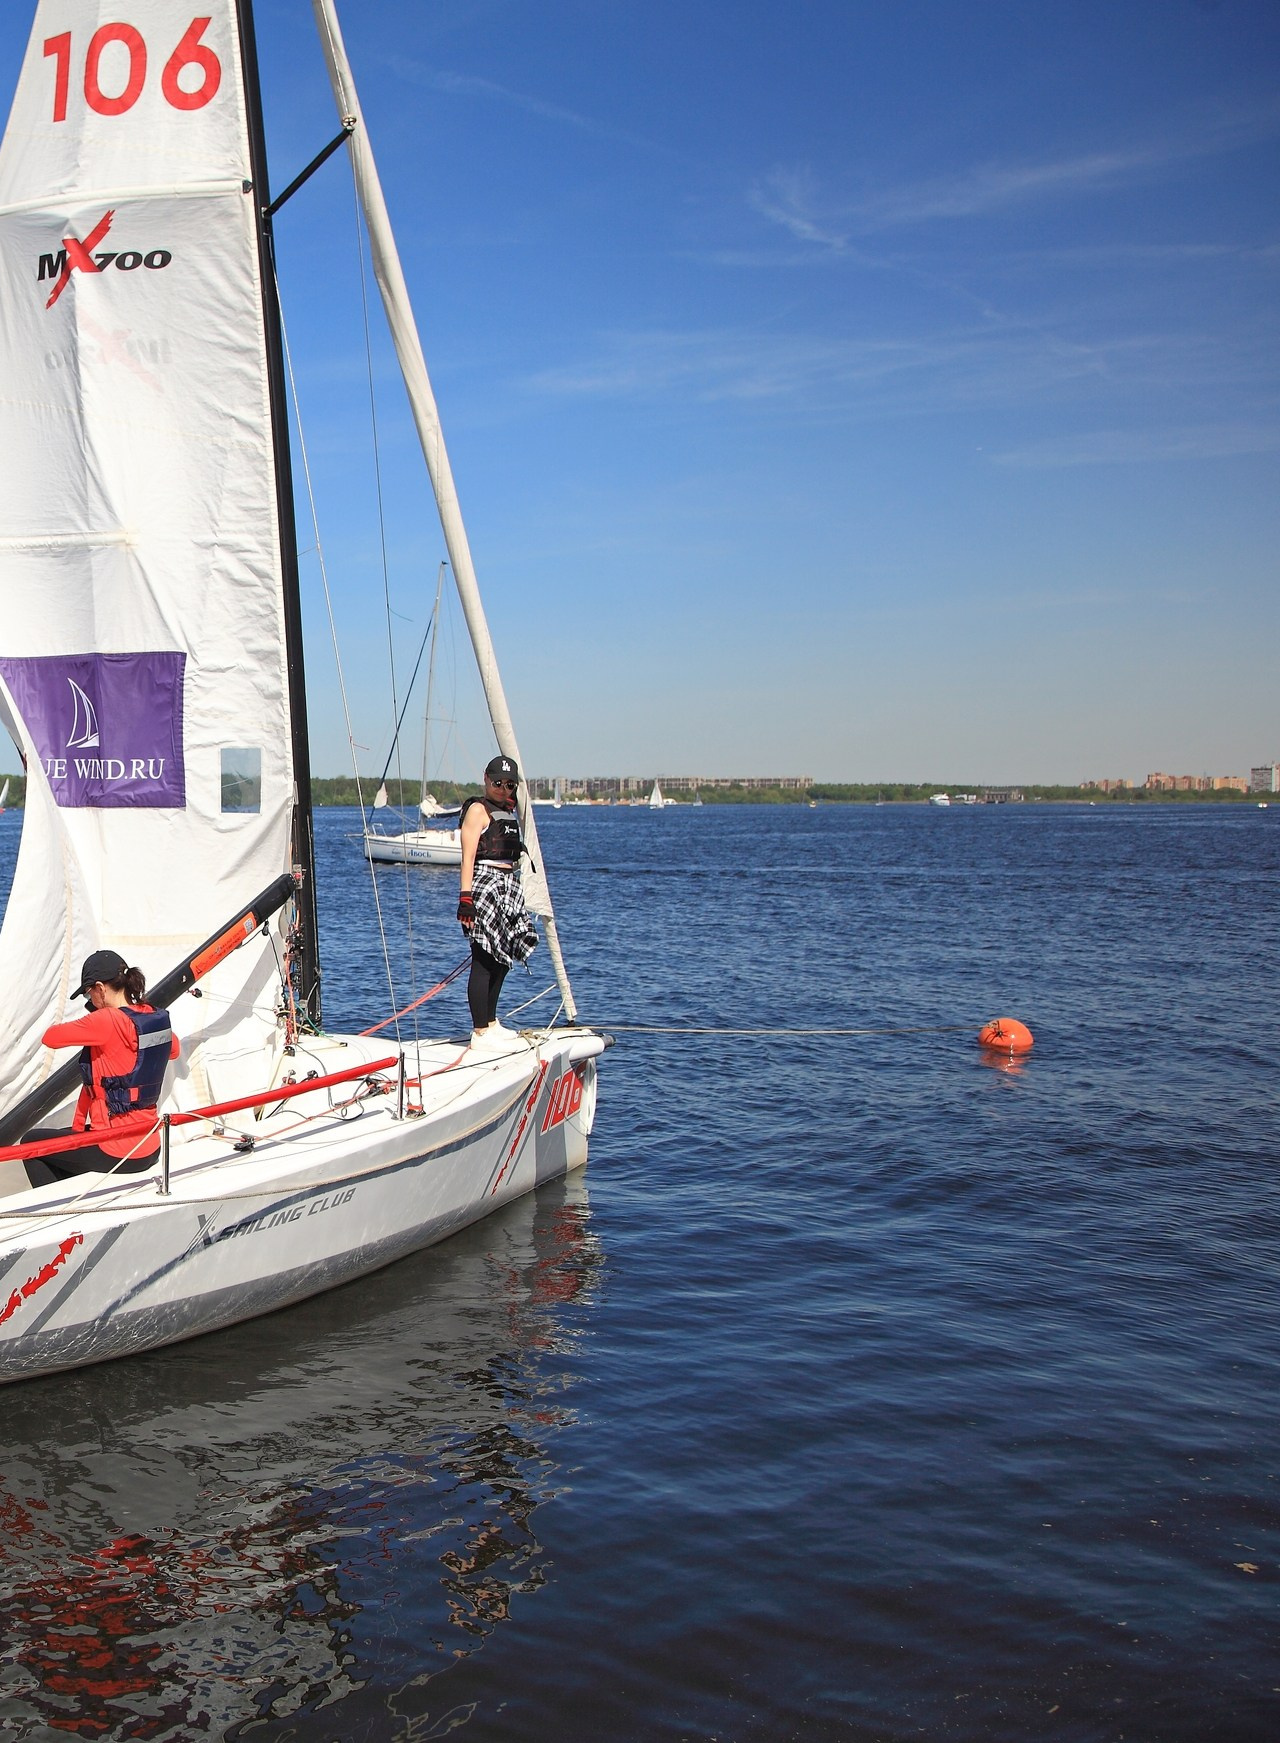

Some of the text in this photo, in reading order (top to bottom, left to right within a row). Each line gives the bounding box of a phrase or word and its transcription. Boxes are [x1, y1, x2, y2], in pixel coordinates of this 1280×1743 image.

[43, 17, 222, 122] 106
[37, 209, 172, 310] MX700
[39, 758, 68, 779] UE
[218, 1205, 306, 1242] SAILING
[307, 1188, 357, 1216] CLUB
